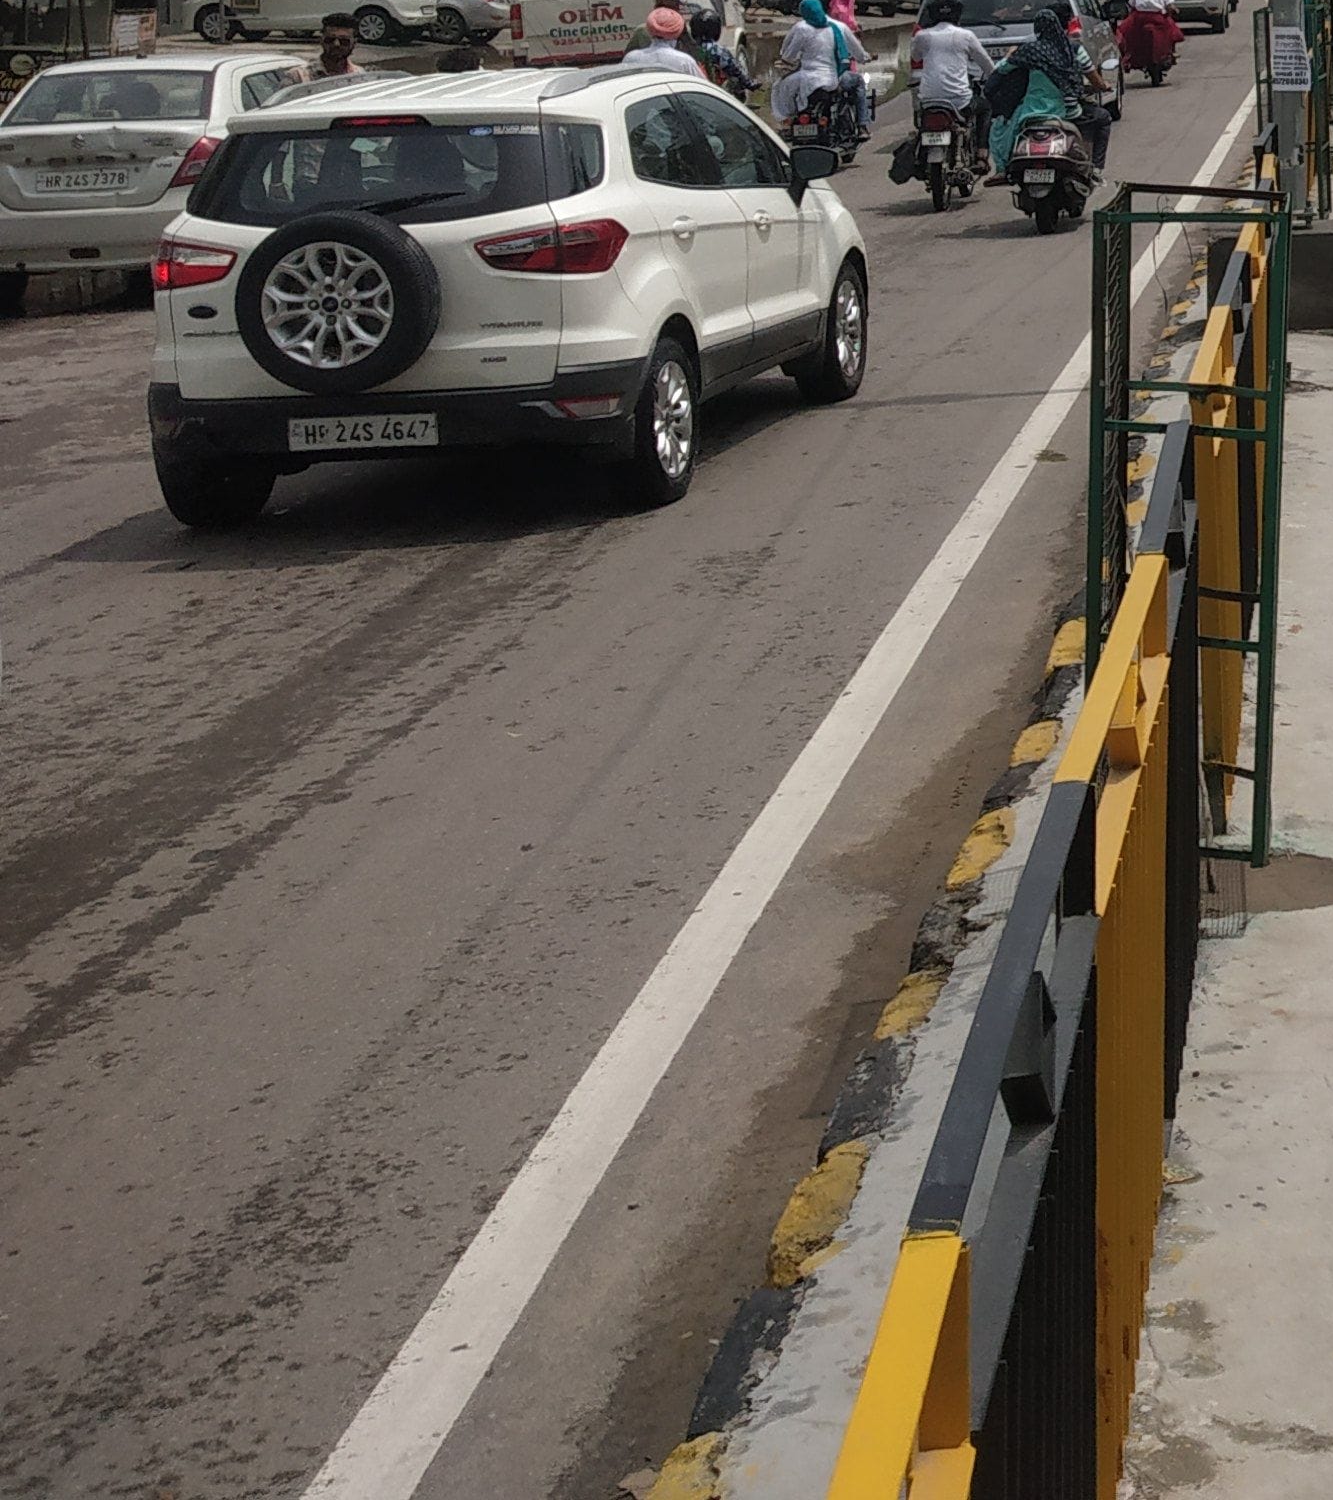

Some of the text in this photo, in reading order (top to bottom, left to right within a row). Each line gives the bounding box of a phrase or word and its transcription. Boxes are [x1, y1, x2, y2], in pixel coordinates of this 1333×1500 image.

[558, 5, 625, 25] OHM
[580, 24, 628, 36] Garden
[45, 172, 126, 189] HR 24S 7378
[335, 422, 374, 443] 24S
[380, 418, 430, 441] 4647
